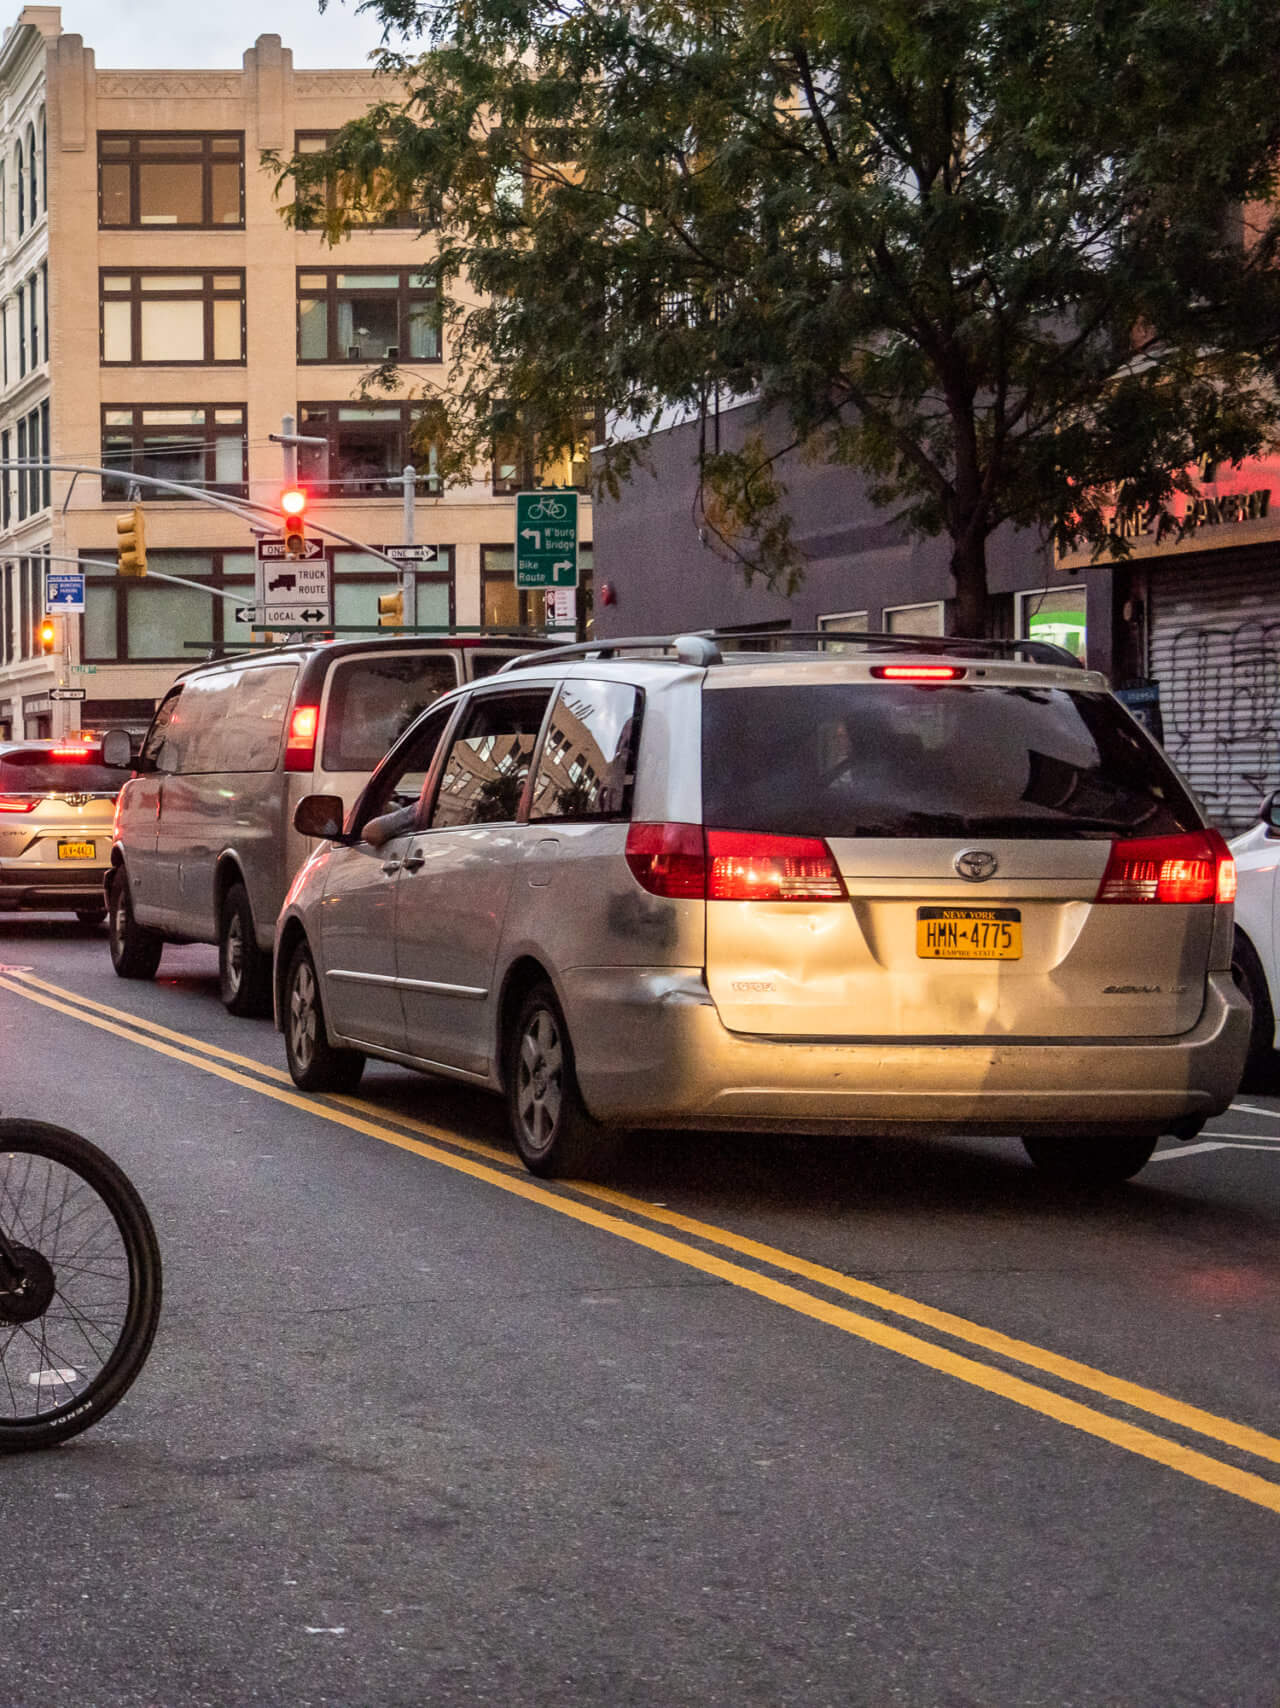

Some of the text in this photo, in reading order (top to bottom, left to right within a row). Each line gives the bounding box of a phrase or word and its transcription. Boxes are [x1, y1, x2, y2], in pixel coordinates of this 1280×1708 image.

[544, 528, 575, 539] W'burg
[266, 544, 285, 555] ONE
[545, 540, 575, 552] Bridge
[391, 549, 430, 558] ONE WAY
[519, 560, 539, 570] Bike
[299, 570, 326, 580] TRUCK
[519, 572, 546, 582] Route
[299, 584, 326, 594] ROUTE
[269, 611, 296, 621] LOCAL
[943, 910, 997, 921] NEW YORK
[49, 1399, 93, 1427] KENDA
